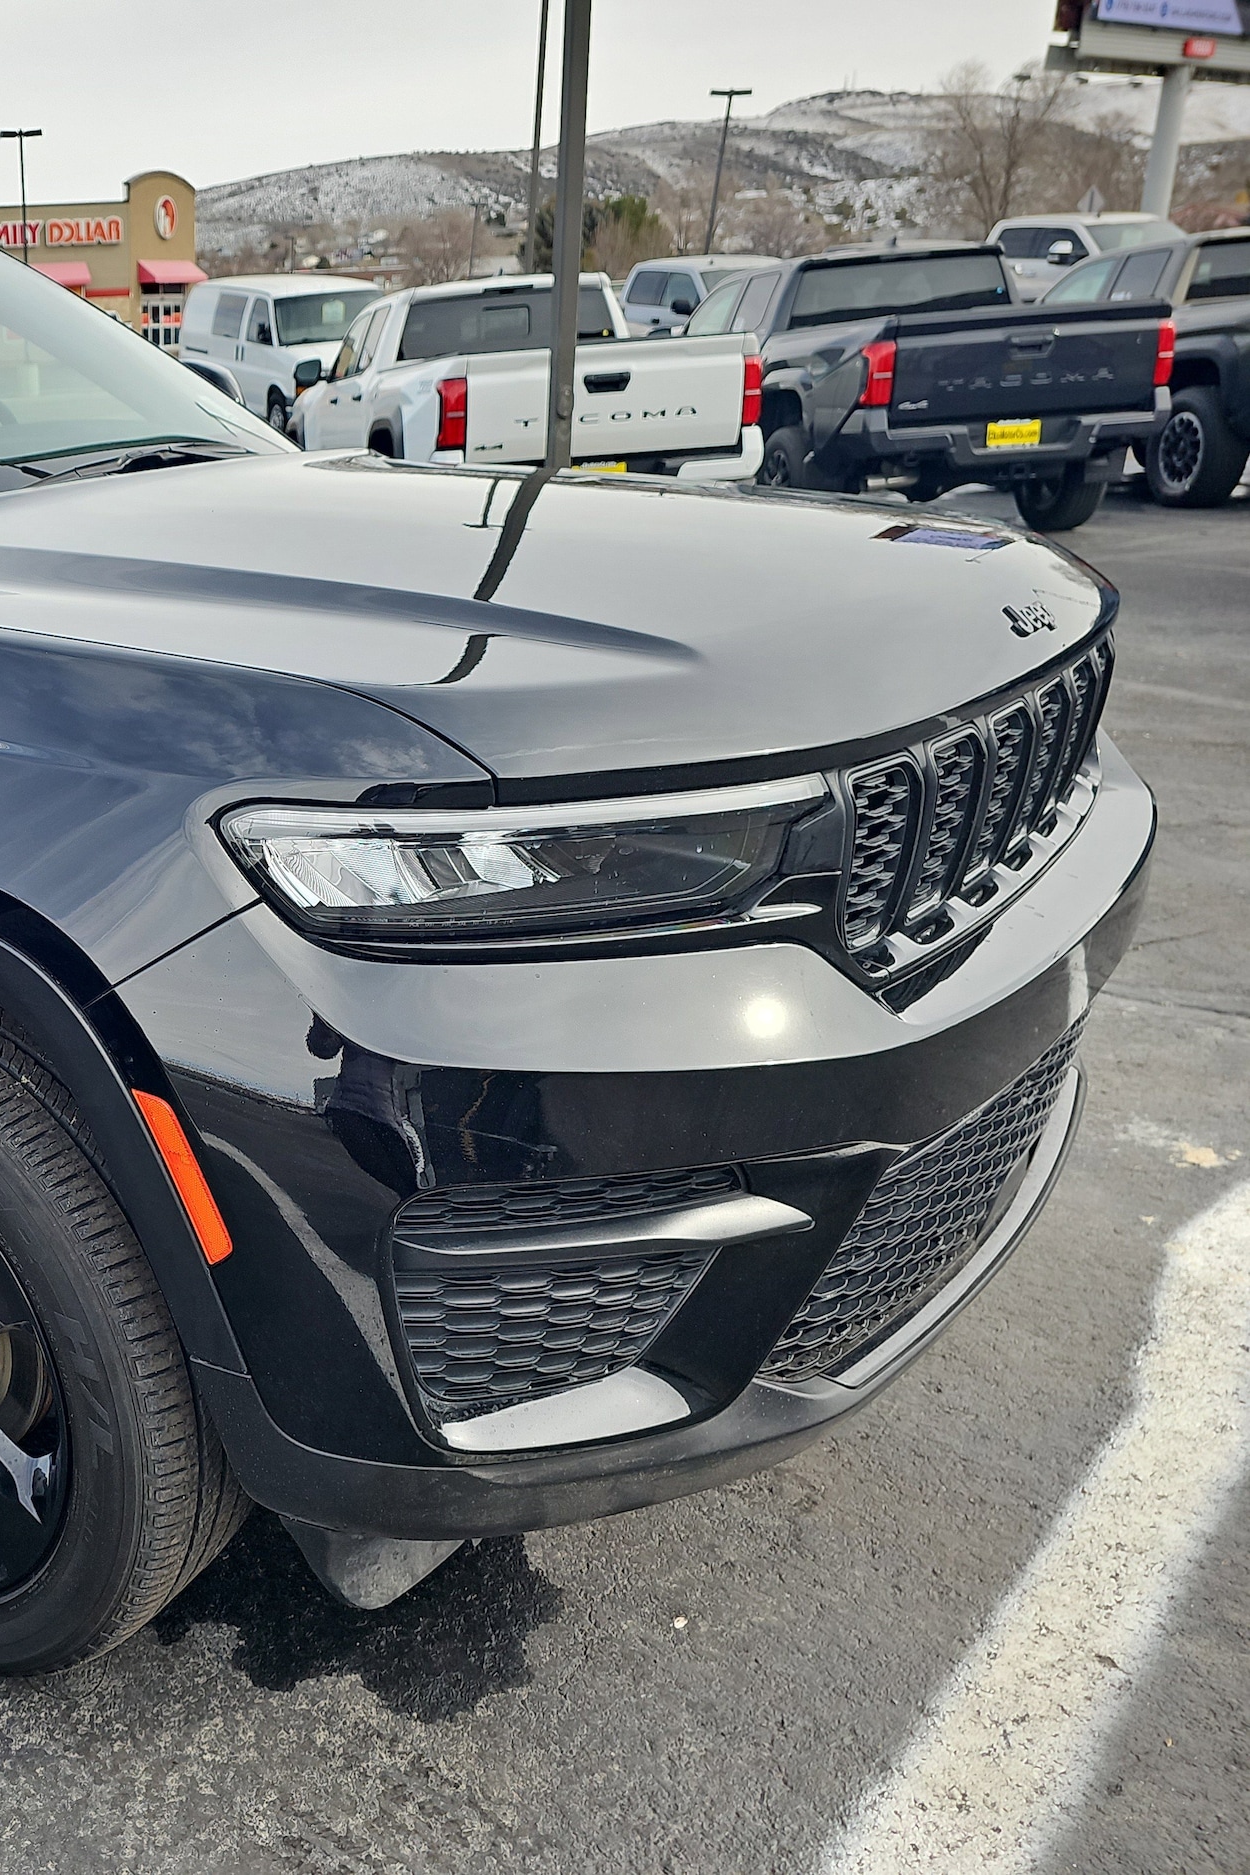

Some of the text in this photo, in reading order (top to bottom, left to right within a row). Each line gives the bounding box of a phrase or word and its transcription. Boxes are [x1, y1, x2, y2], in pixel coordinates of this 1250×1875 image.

[47, 219, 122, 245] DOLLAR
[937, 366, 1115, 392] TACOMA
[514, 404, 698, 428] TCOMA
[1002, 601, 1056, 638] Jeep
